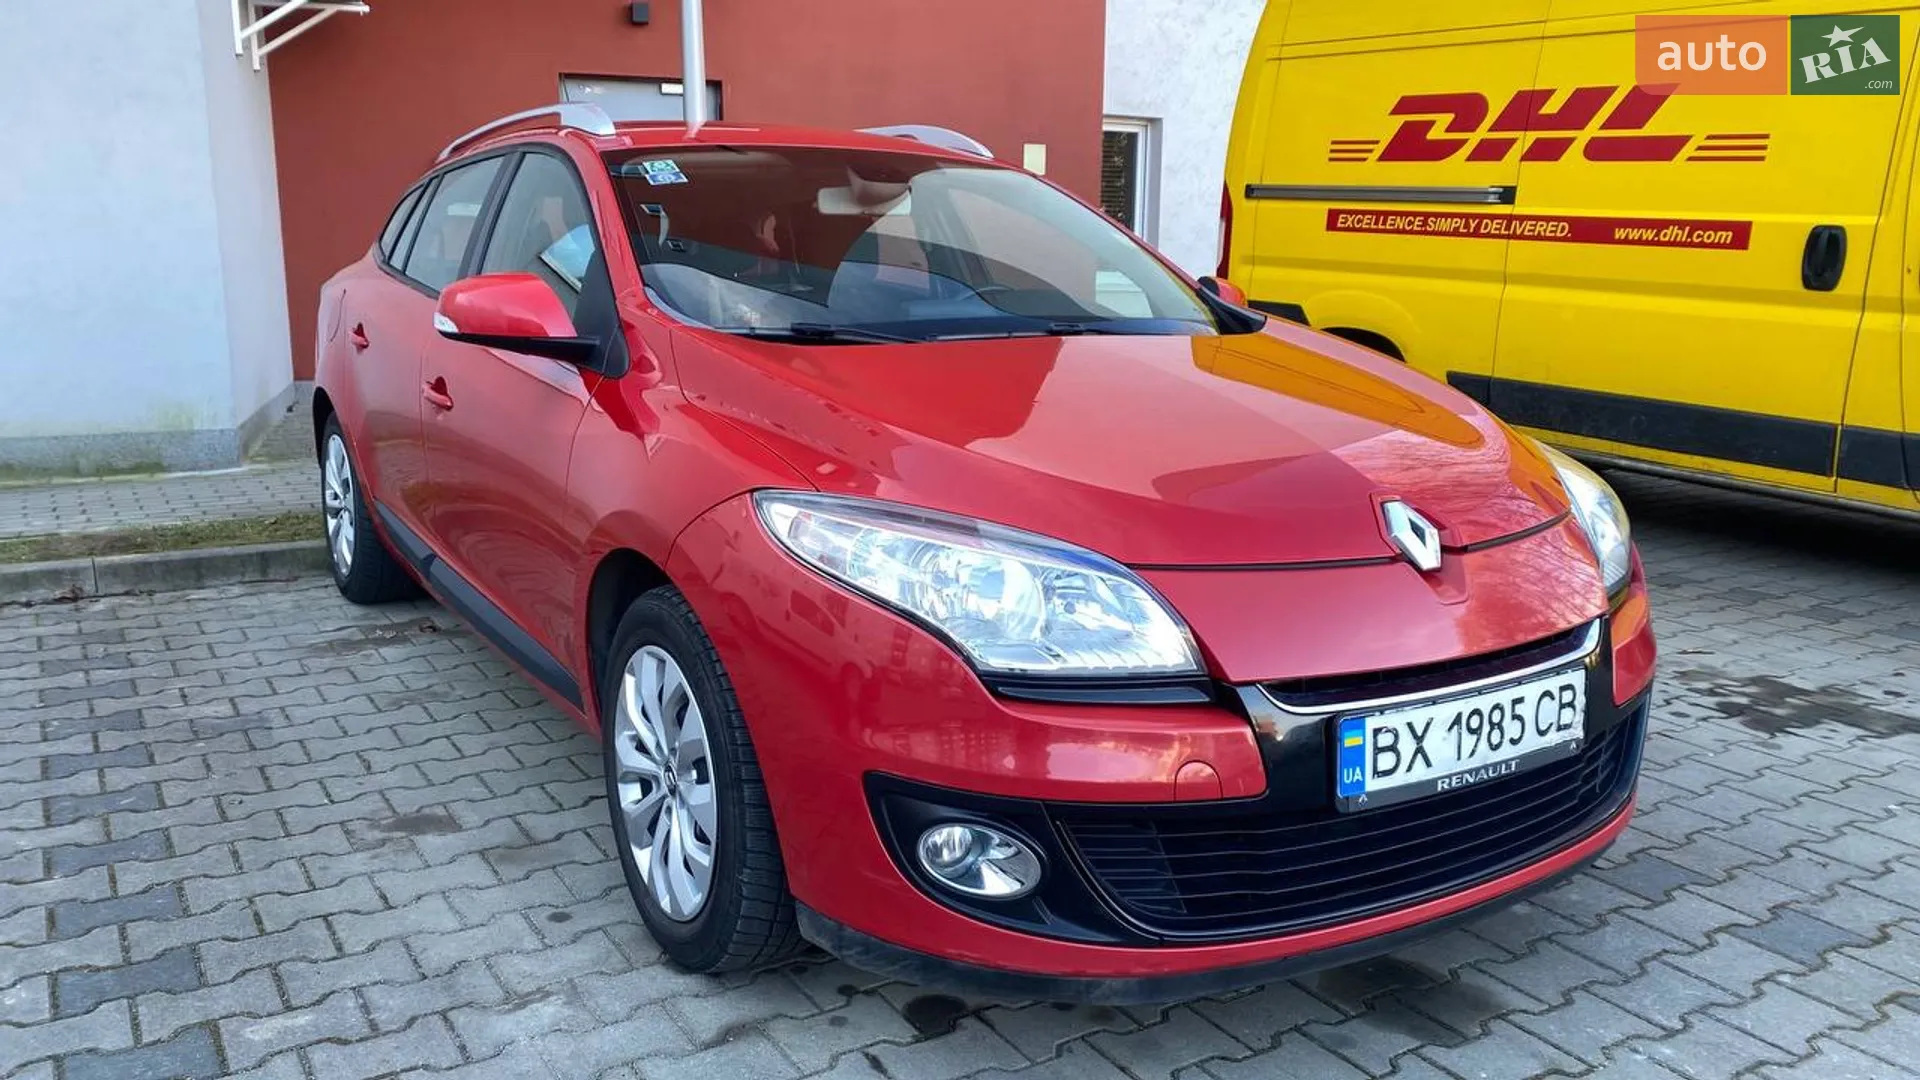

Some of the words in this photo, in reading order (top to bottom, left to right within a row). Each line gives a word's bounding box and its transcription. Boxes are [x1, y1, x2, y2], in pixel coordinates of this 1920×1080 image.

[1376, 82, 1693, 162] DHL
[1480, 219, 1572, 237] DELIVERED.
[1614, 225, 1734, 244] www.dhl.com
[1372, 716, 1435, 780] BX
[1447, 695, 1526, 762] 1985
[1534, 683, 1578, 738] CB
[1343, 765, 1363, 784] UA
[1436, 758, 1521, 792] RENAULT
